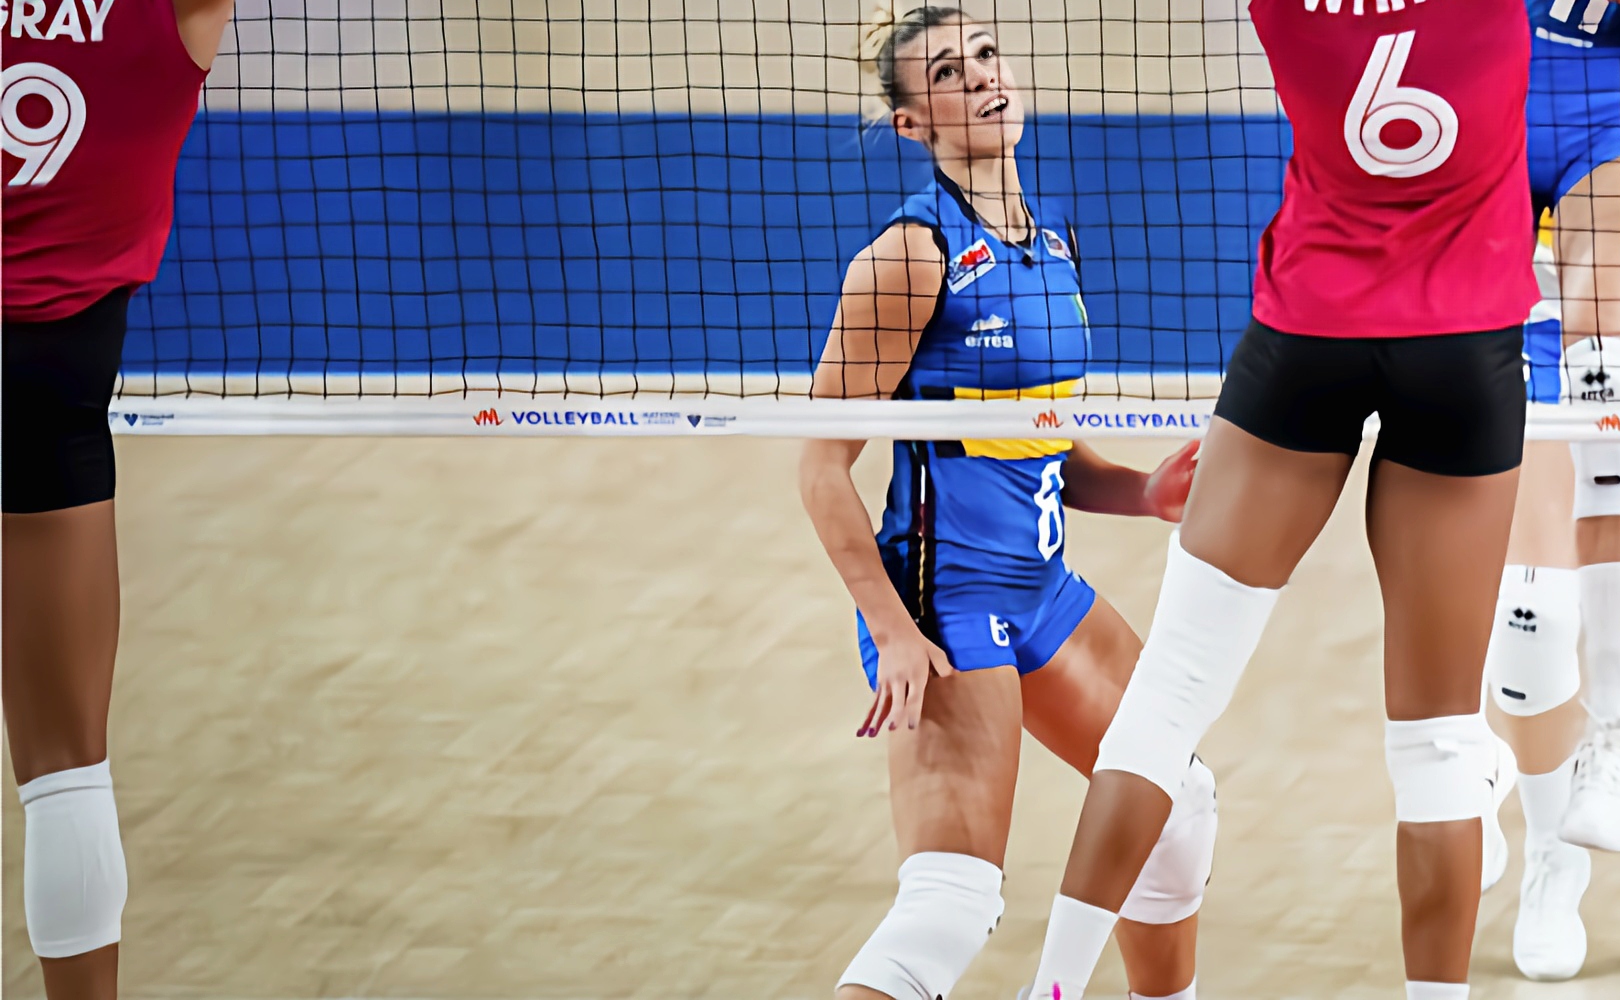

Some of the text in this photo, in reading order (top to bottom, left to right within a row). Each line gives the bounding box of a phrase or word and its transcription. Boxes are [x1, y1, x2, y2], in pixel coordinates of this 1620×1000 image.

[1, 61, 87, 187] 9
[1343, 30, 1459, 179] 6
[511, 410, 639, 426] VOLLEYBALL
[1073, 413, 1200, 428] VOLLEYBALL
